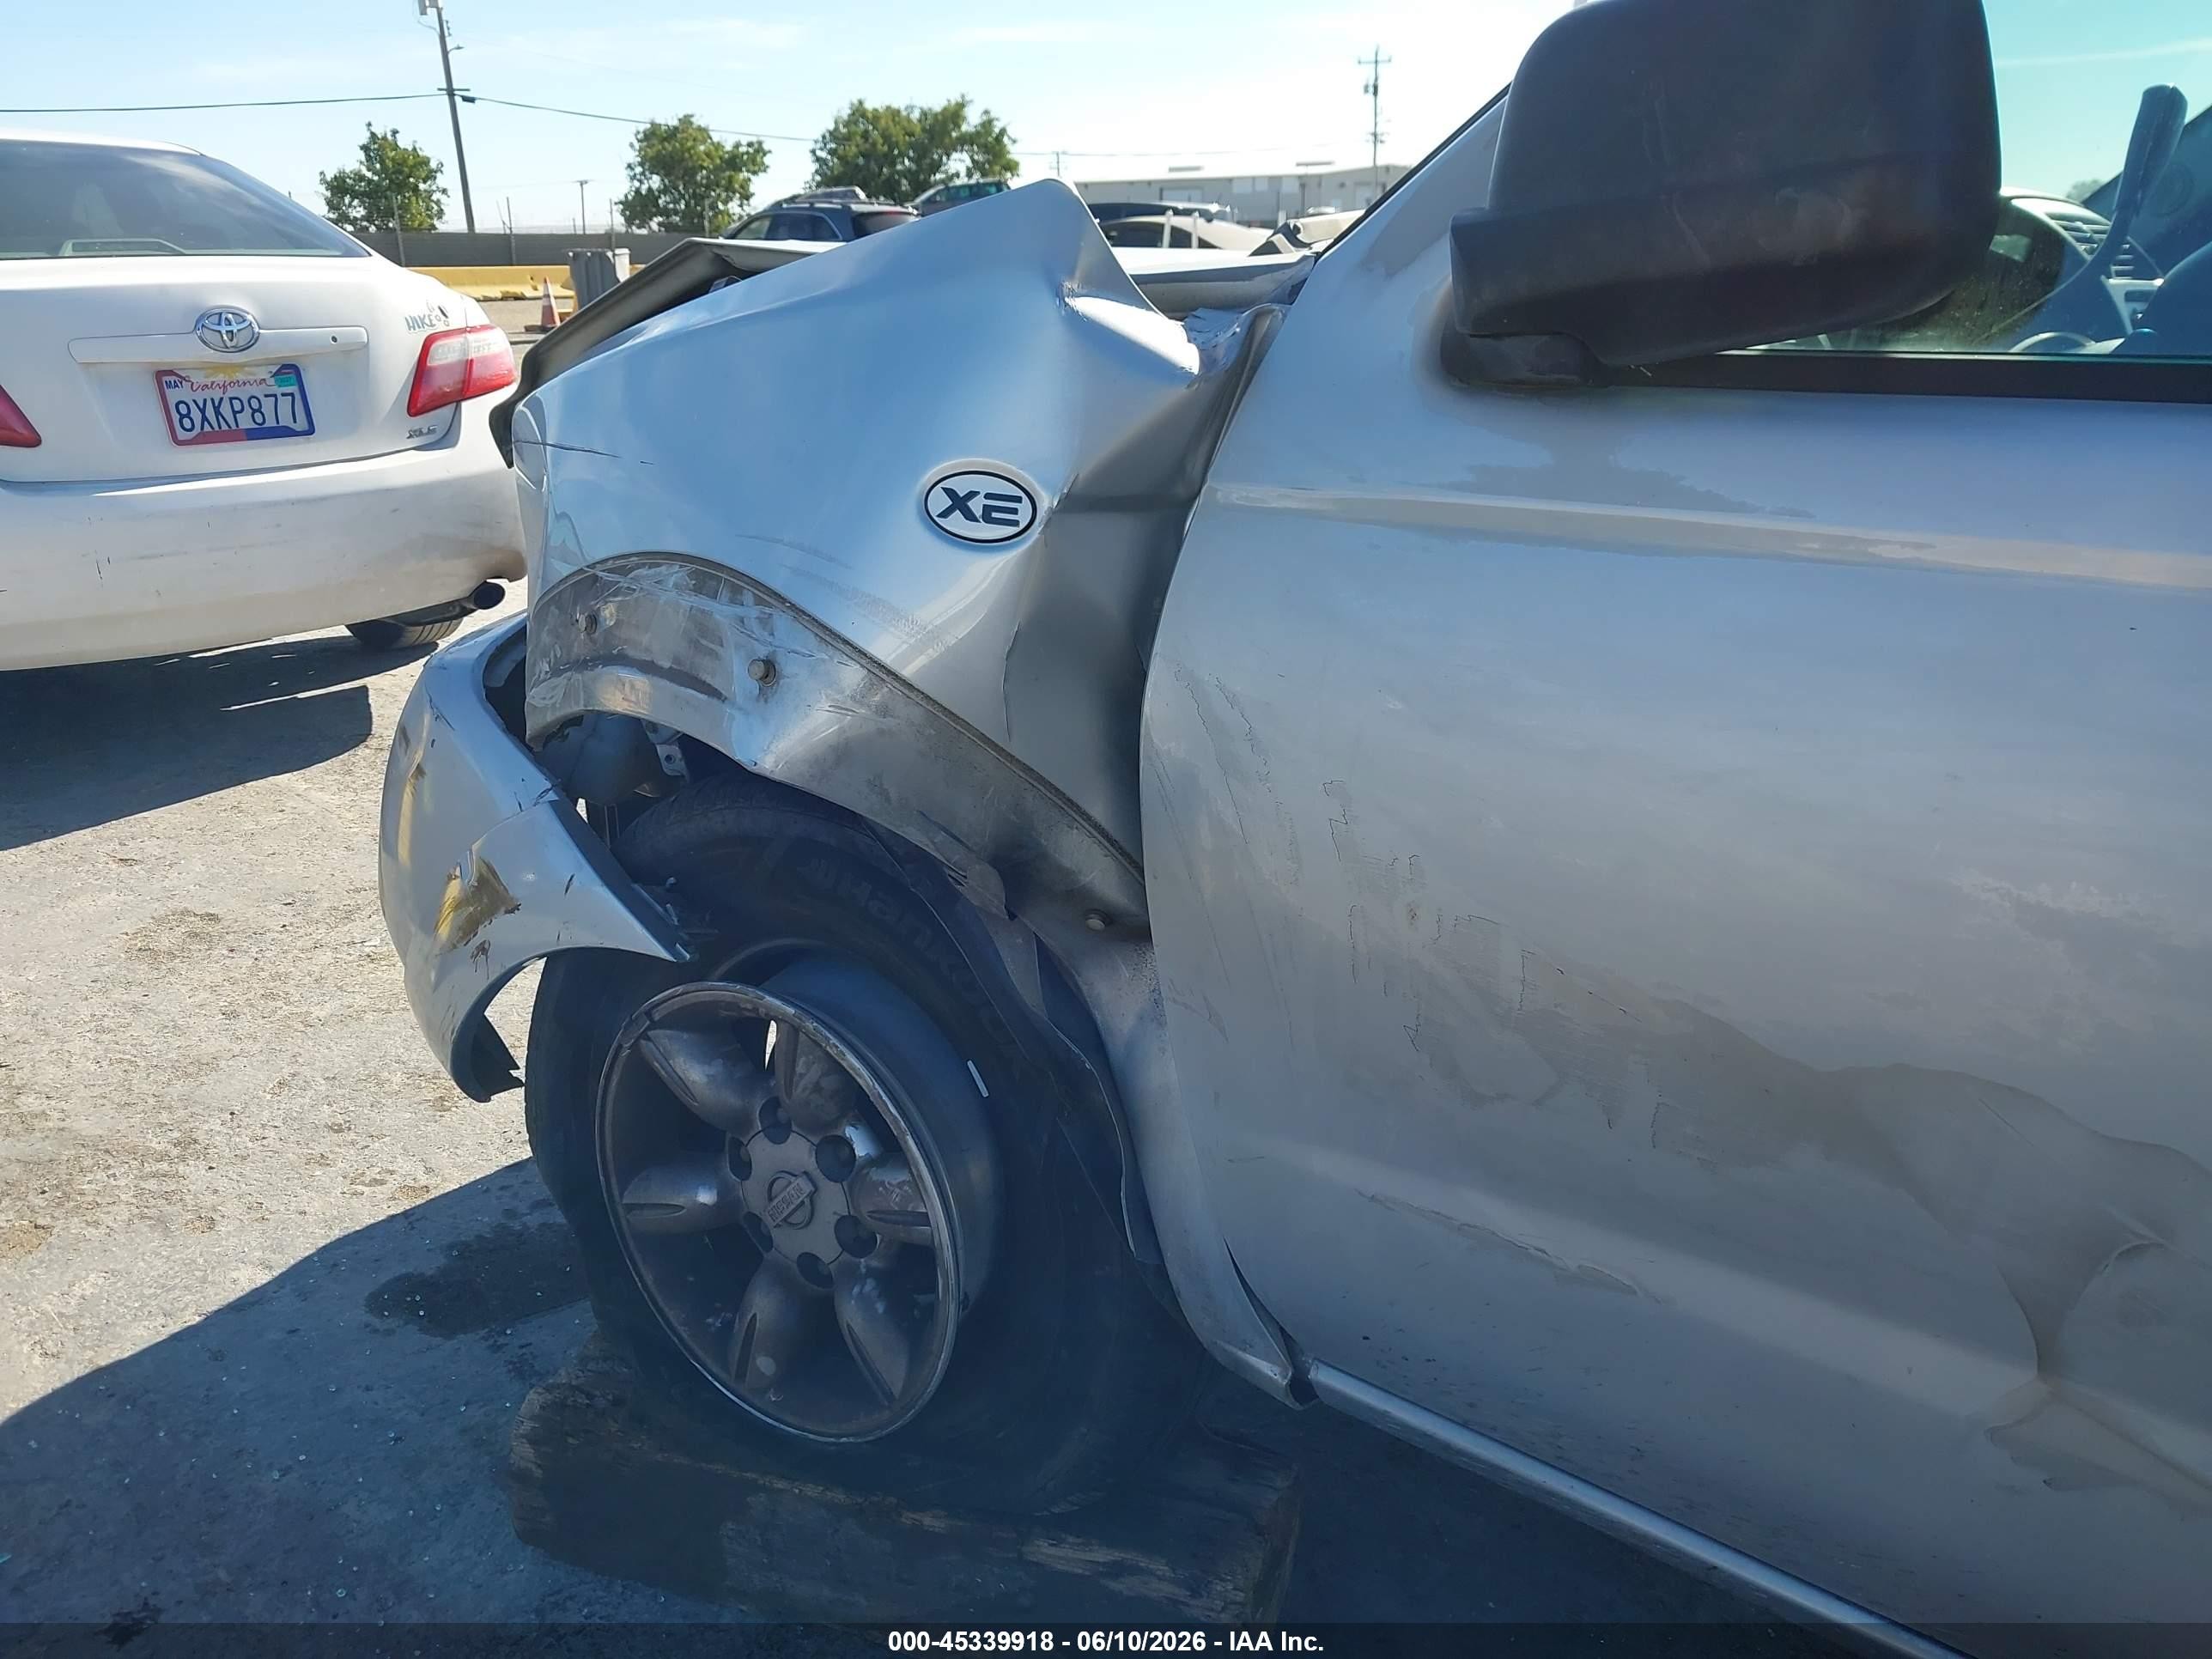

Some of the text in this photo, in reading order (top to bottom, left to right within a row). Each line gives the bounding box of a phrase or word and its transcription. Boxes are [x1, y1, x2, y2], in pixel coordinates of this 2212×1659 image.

[165, 380, 184, 390] MAY
[186, 376, 275, 394] California
[175, 392, 296, 433] 8XKP877
[935, 486, 1023, 528] XE
[768, 1182, 805, 1223] NISSAN
